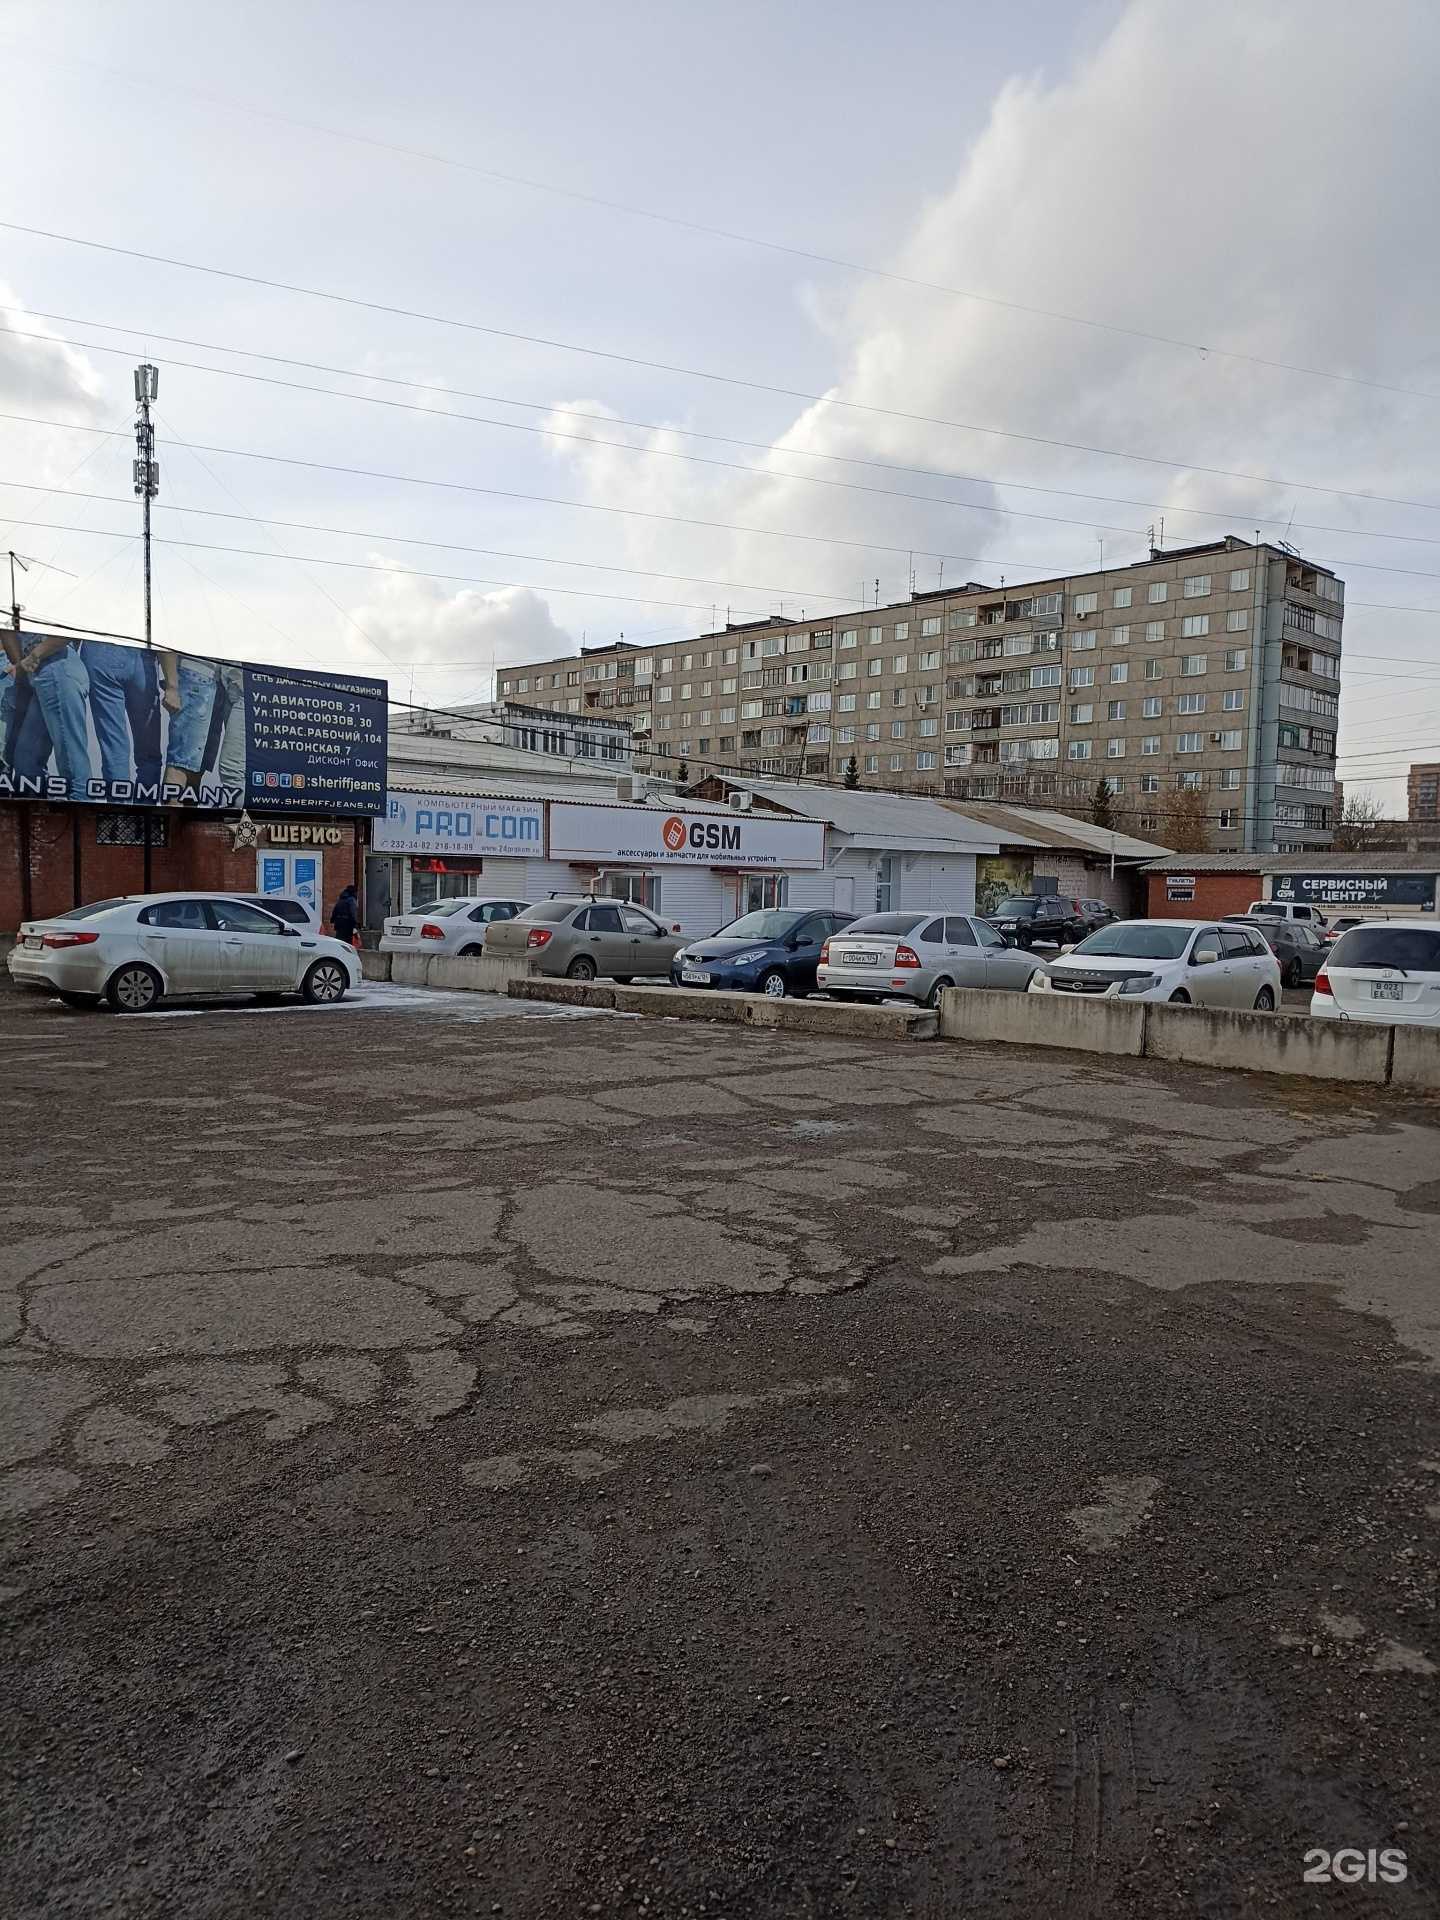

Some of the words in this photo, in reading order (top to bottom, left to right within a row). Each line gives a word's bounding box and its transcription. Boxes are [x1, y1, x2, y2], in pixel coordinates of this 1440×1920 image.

[252, 673, 273, 683] СЕТЬ
[333, 683, 382, 696] МАГАЗИНОВ
[349, 703, 361, 713] 21
[360, 718, 372, 728] 30
[345, 746, 352, 755] 7
[308, 755, 351, 766] ДИСКОНТ
[355, 759, 379, 769] ОФИС
[87, 778, 241, 804] COMPANY
[417, 800, 497, 812] КОМПЬЮТЕРНЫЙ
[499, 805, 539, 813] МАГАЗИН
[689, 822, 741, 850] GSM
[617, 849, 659, 858] аксессуары
[666, 851, 695, 859] запчасти
[1302, 878, 1387, 890] СЕРВИСНЫЙ
[1321, 891, 1367, 901] ЦЕНТР
